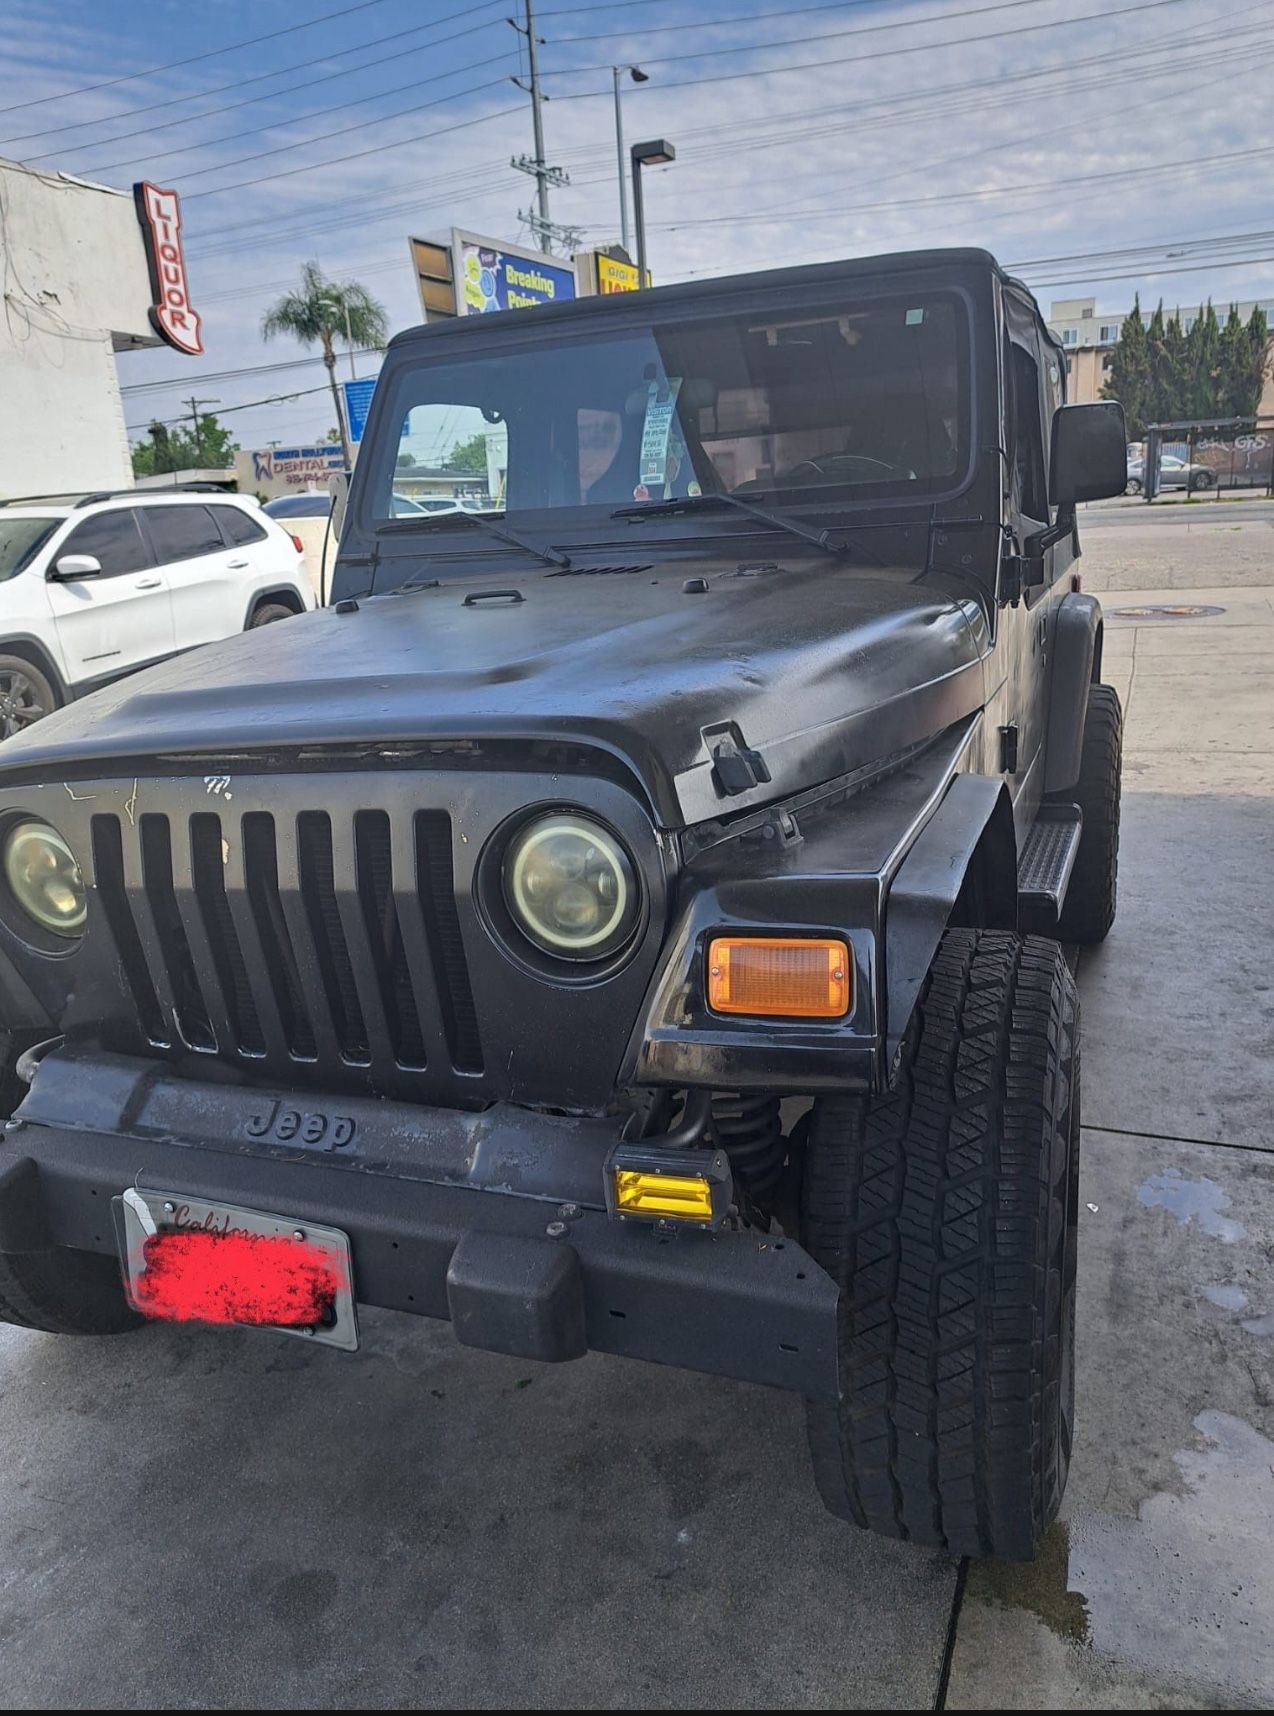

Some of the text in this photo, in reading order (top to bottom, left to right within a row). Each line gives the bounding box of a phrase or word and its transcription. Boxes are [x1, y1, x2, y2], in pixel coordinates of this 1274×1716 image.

[154, 198, 190, 331] LIQUOR
[505, 264, 555, 299] Breaking
[273, 458, 328, 473] DENTAL
[245, 1098, 357, 1153] Jeep
